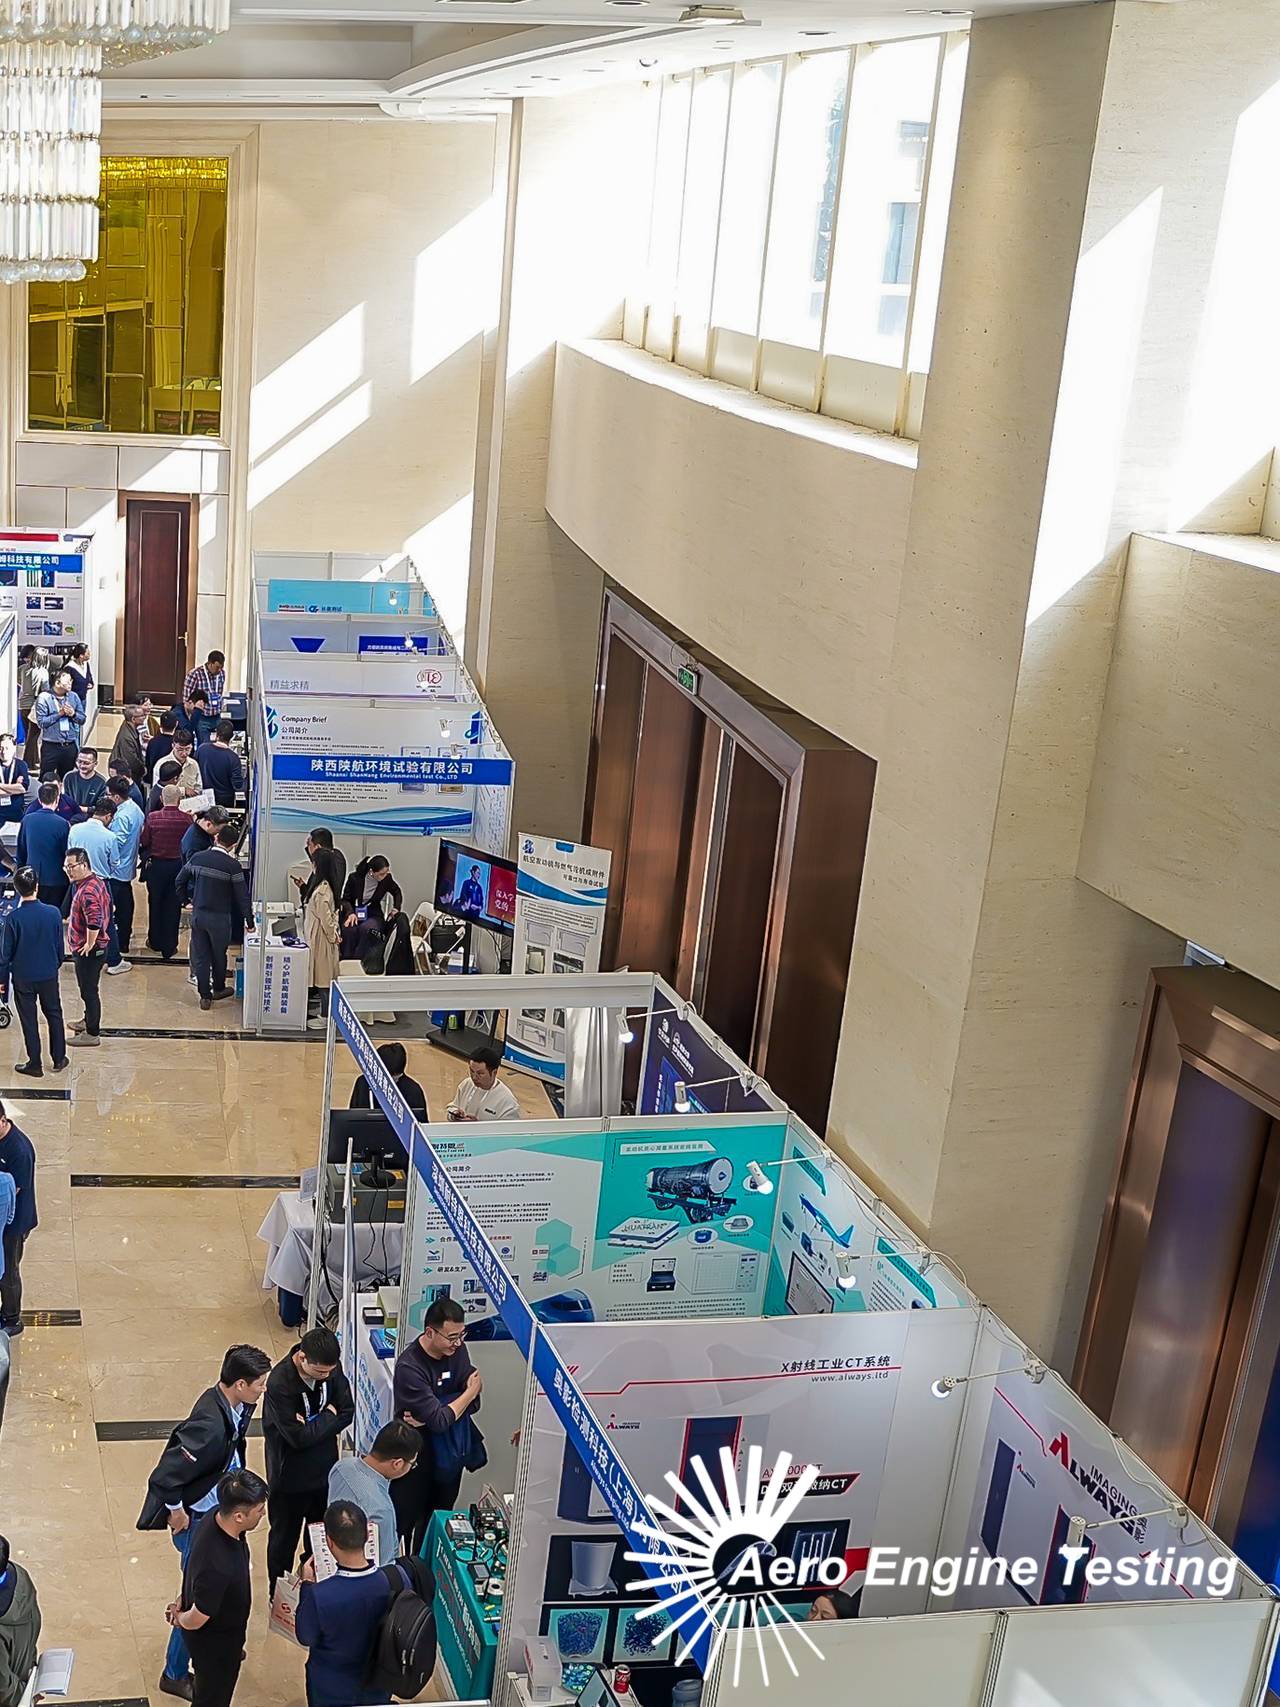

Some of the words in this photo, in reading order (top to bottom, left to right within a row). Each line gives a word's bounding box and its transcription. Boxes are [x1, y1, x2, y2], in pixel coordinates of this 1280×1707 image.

[270, 680, 310, 690] 精益求精
[282, 715, 311, 724] Company
[282, 726, 308, 734] 公司简介
[311, 759, 473, 774] 陕西陕航环境试验有限公司
[781, 1355, 891, 1373] X射线工业CT系统
[811, 1371, 889, 1383] www.always.ltd
[1091, 1465, 1138, 1516] IMAGING
